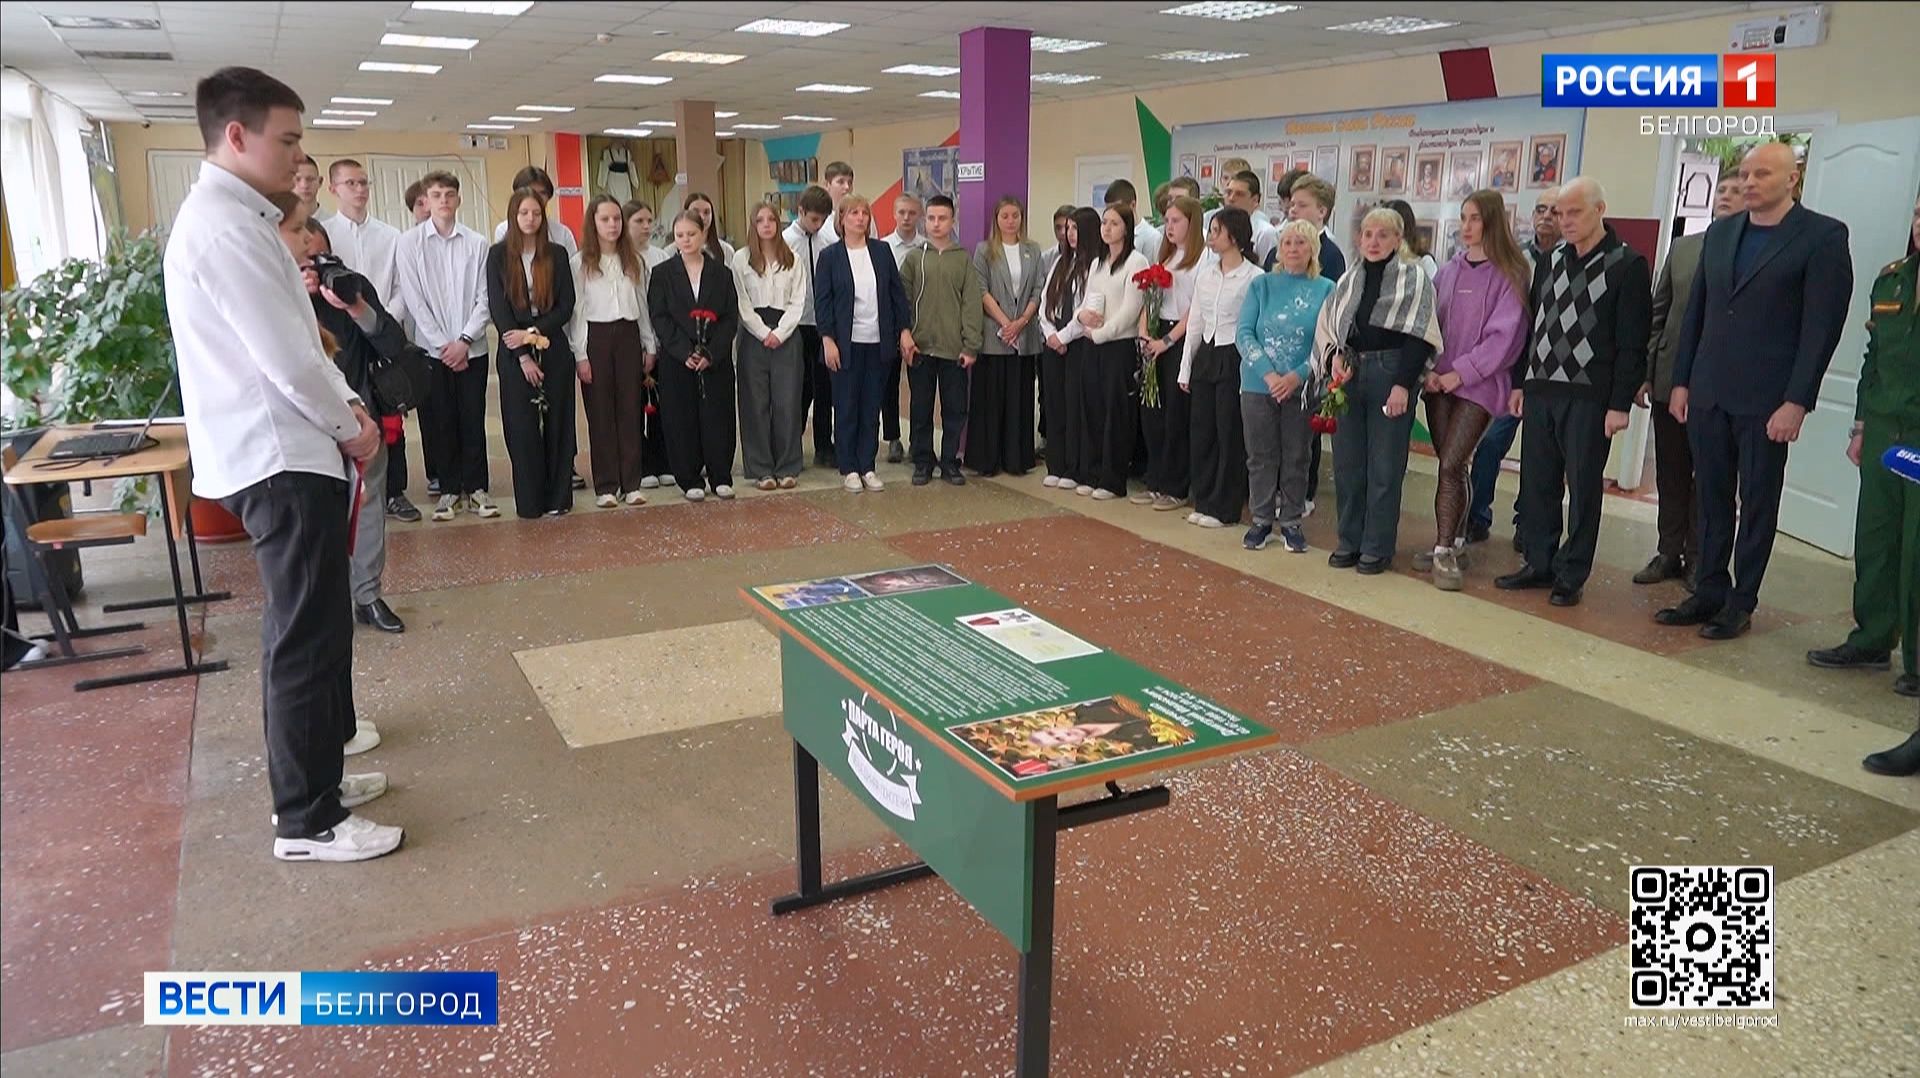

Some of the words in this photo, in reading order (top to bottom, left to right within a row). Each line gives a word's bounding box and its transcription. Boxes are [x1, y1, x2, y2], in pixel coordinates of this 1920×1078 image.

[960, 165, 983, 177] КРЫТИЕ
[848, 698, 880, 742] ПАРТА
[880, 726, 913, 771] ГЕРОЯ
